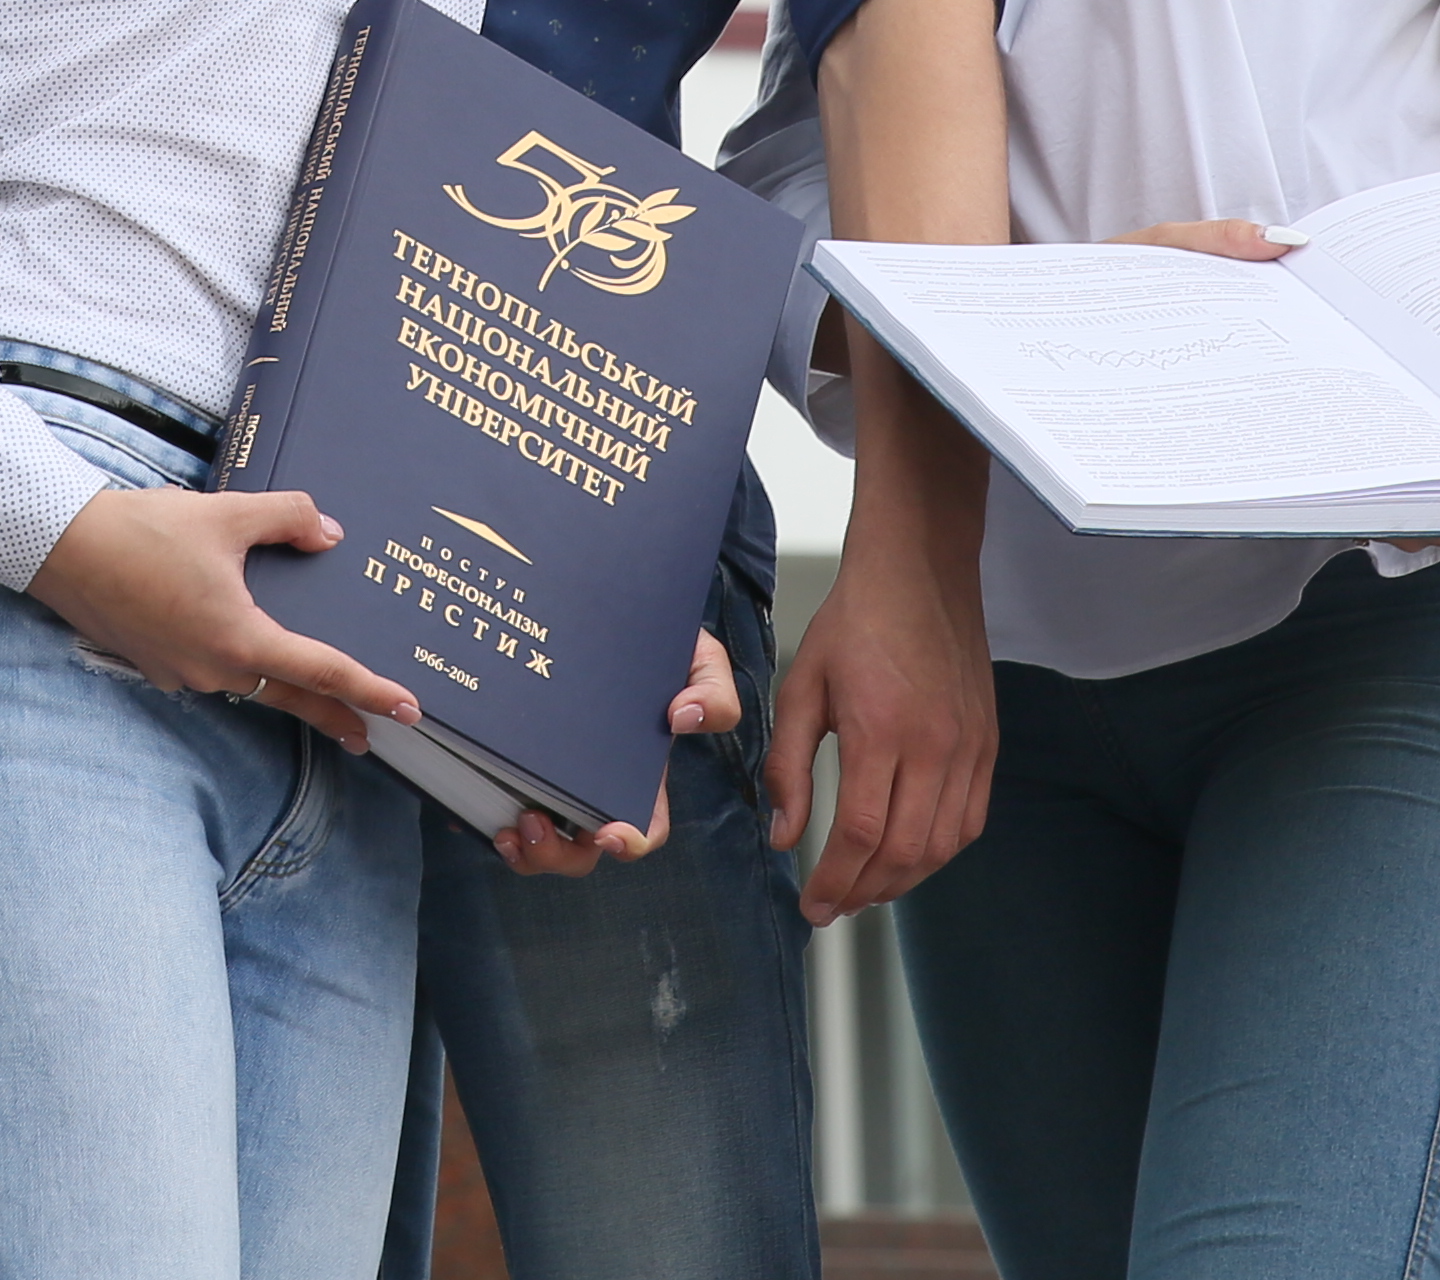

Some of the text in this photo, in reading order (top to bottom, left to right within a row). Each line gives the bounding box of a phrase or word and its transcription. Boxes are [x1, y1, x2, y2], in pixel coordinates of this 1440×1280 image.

[270, 24, 371, 333] ТЕРНОПІЛЬСЬКИЙ НАЦІОНАЛЬНИЙ
[392, 228, 698, 426] ТЕРНОПІЛЬСЬКИЙ
[395, 274, 672, 452] НАЦІОНАЛЬНИЙ
[217, 383, 257, 491] ПРОФЕСІОНАЛІЗ
[235, 414, 261, 469] ПОСТУП
[396, 317, 652, 482] ЕКОНОМІЧНИЙ
[405, 362, 625, 506] УНІВЕРСИТЕТ
[363, 556, 554, 679] ПРЕСТИЖ
[384, 539, 549, 642] ПРОФЕСІОНАЛІЗМ
[420, 535, 526, 603] ПОСТУП
[412, 645, 480, 692] 1966-2016
